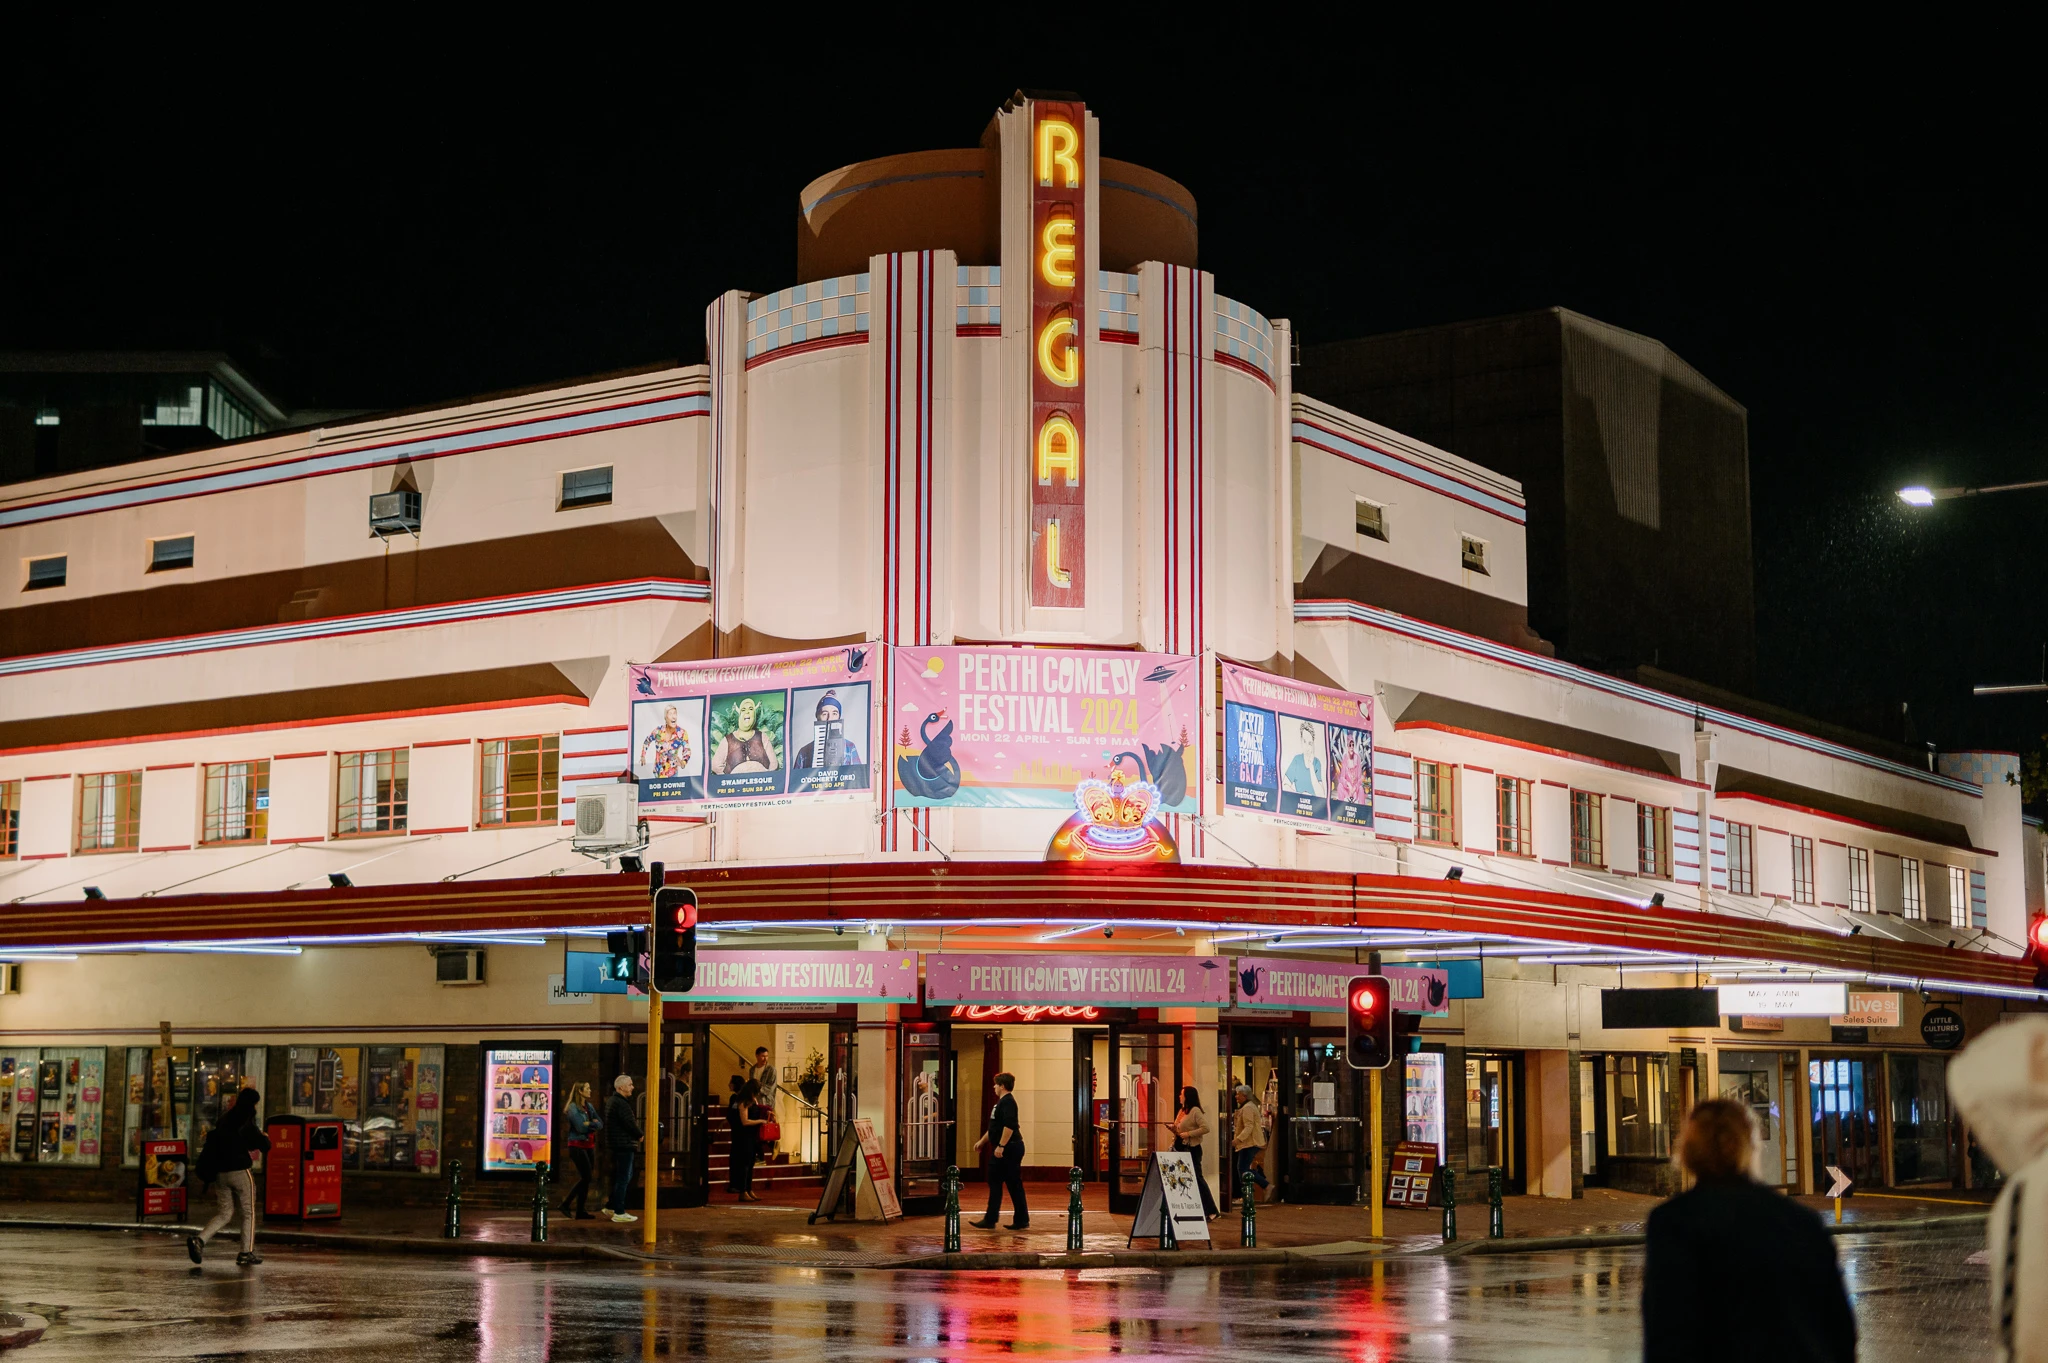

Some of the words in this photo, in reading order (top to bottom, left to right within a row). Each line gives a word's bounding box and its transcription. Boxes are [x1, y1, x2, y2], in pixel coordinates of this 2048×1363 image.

[1039, 119, 1080, 589] REGAL
[773, 660, 796, 669] MON
[800, 658, 813, 667] 22
[816, 655, 844, 665] APRIL
[657, 671, 685, 688] PERTH
[684, 668, 718, 686] COMEDY
[720, 664, 760, 684] FESTIVAL
[760, 663, 773, 678] 24
[782, 668, 804, 678] SUN
[822, 664, 845, 674] MAY
[958, 653, 1038, 692] PERTH
[1042, 656, 1141, 696] COMEDY
[1242, 676, 1262, 696] PERTH
[1284, 686, 1310, 706] FESTIVAL
[1309, 693, 1317, 708] 24
[1342, 700, 1358, 709] APRIL
[958, 693, 1074, 734] FESTIVAL
[1080, 698, 1140, 736] 2024
[1344, 708, 1358, 718] MAY
[1238, 710, 1264, 736] PERTH
[960, 734, 990, 742] MON
[994, 734, 1011, 742] 22
[1015, 734, 1050, 744] APRIL
[1066, 736, 1091, 745] SUN
[1094, 737, 1107, 746] 19
[1111, 737, 1140, 746] MAY
[1239, 747, 1265, 766] FESTIVAL
[800, 776, 838, 784] O'DOHERTY
[1240, 762, 1263, 785] GALA
[721, 776, 773, 787] SWAMPLESQUE
[718, 962, 780, 988] COMEDY
[782, 963, 853, 988] FESTIVAL
[855, 964, 874, 988] 24
[970, 966, 1022, 992] PERTH
[1024, 966, 1088, 992] COMEDY
[1091, 967, 1165, 992] FESTIVAL
[1166, 968, 1186, 993] 24
[1269, 970, 1307, 997] PERTH
[1405, 978, 1419, 1002] 24
[1843, 1016, 1865, 1024] Sales
[1866, 1016, 1888, 1024] Suite
[1930, 1016, 1952, 1024] LITTLE
[1924, 1024, 1960, 1032] CULTURES
[154, 1145, 176, 1153] KEBAB
[316, 1164, 335, 1172] WASTE
